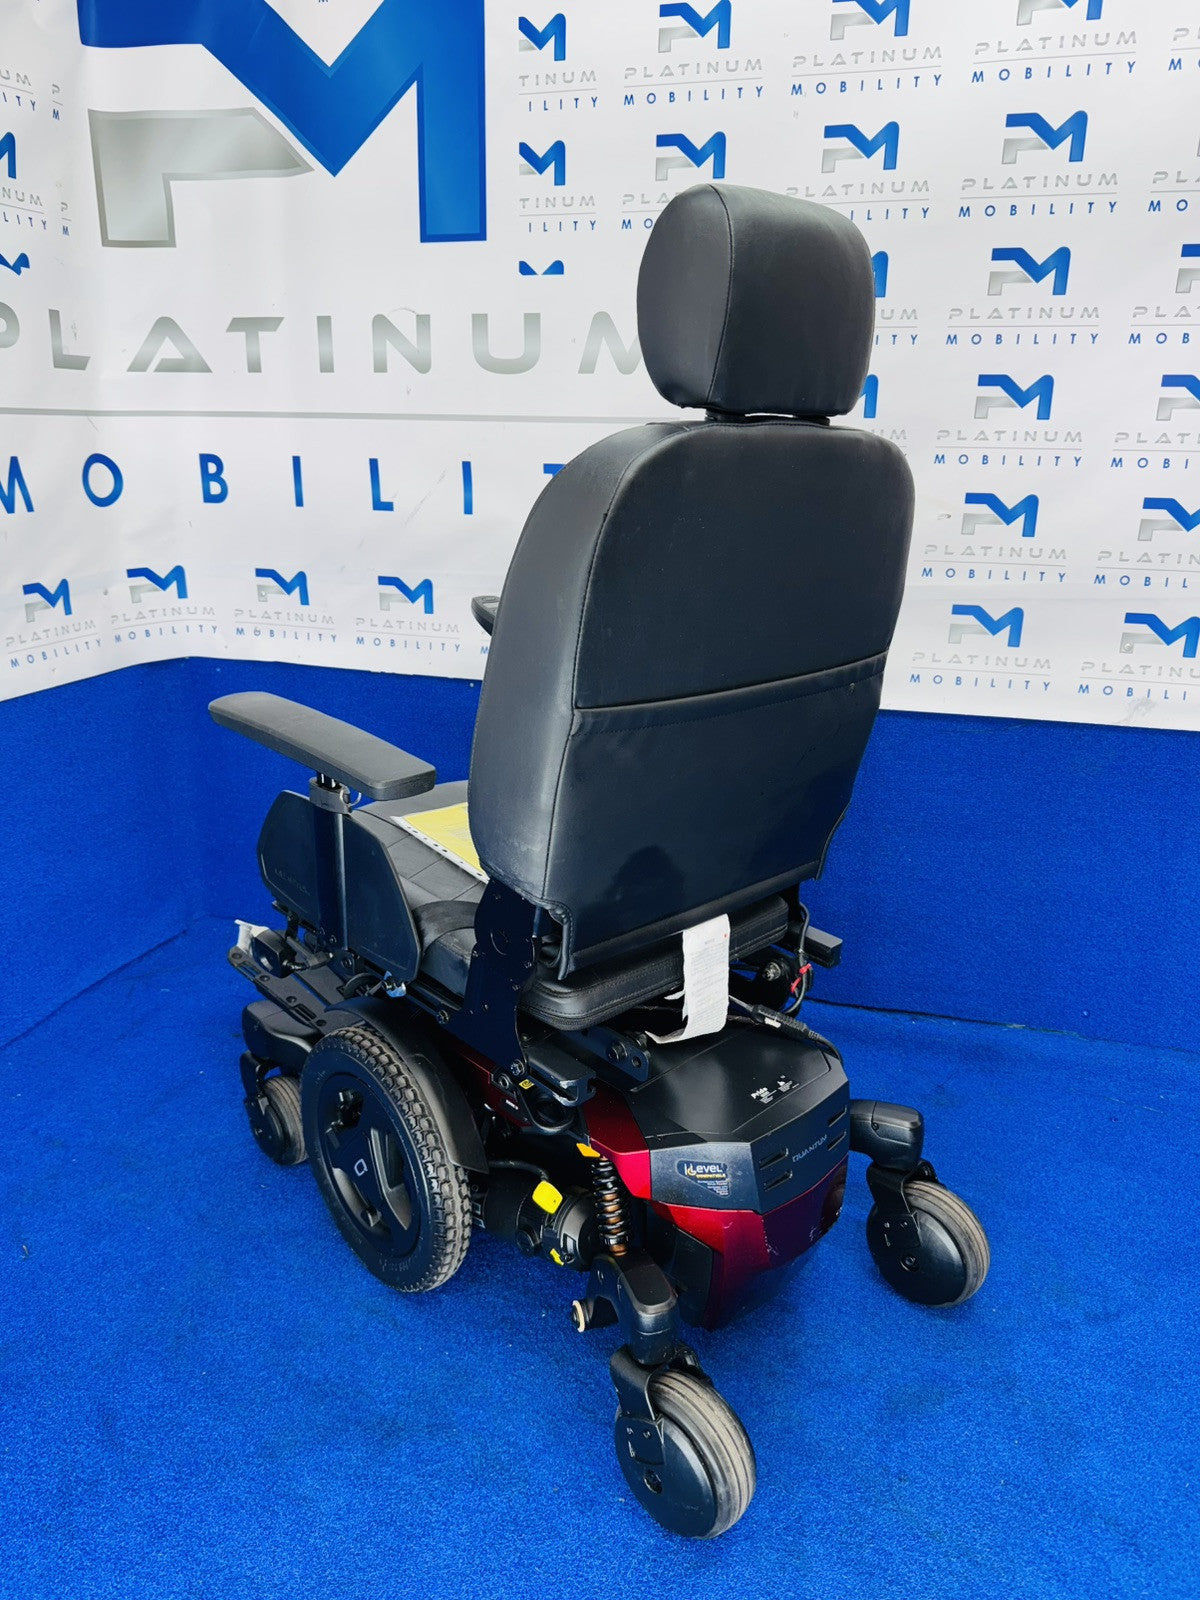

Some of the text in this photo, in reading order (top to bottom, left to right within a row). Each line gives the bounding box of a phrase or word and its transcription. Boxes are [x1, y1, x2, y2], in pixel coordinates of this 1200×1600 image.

[974, 30, 1137, 58] PLATINUM
[792, 46, 942, 70] PLATINUM
[518, 69, 597, 87] TINUM
[624, 58, 763, 82] PLATINUM
[970, 59, 1137, 84] MOBILITY
[790, 72, 942, 96] MOBILITY
[623, 85, 764, 106] MOBILITY
[528, 96, 599, 113] ILITY
[961, 172, 1119, 191] PLATINUM
[518, 195, 596, 209] TINUM
[957, 200, 1118, 218] MOBILITY
[1147, 198, 1189, 213] MO
[849, 206, 931, 221] ILITY
[528, 219, 597, 233] ILITY
[948, 306, 1100, 320] PLATINUM
[945, 332, 1099, 346] MOBILITY
[1127, 332, 1190, 345] MOB
[936, 429, 1083, 443] PLATINUM
[933, 453, 1083, 467] MOBILITY
[924, 544, 1067, 560] PLATINUM
[921, 567, 1067, 583] MOBILITY
[1093, 573, 1188, 589] MOBIL
[110, 606, 215, 625] PLATINUM
[234, 608, 335, 625] PLATINUM
[5, 617, 96, 649] PLATINUM
[355, 617, 458, 633] PLATINUM
[114, 624, 218, 644] MOBILITY
[235, 627, 337, 643] MOBILITY
[7, 636, 101, 668] MOBILITY
[355, 636, 461, 653] MOBILITY
[912, 652, 1051, 669] PLATINUM
[909, 673, 1051, 692] MOBILITY
[1077, 683, 1187, 701] MOBILI
